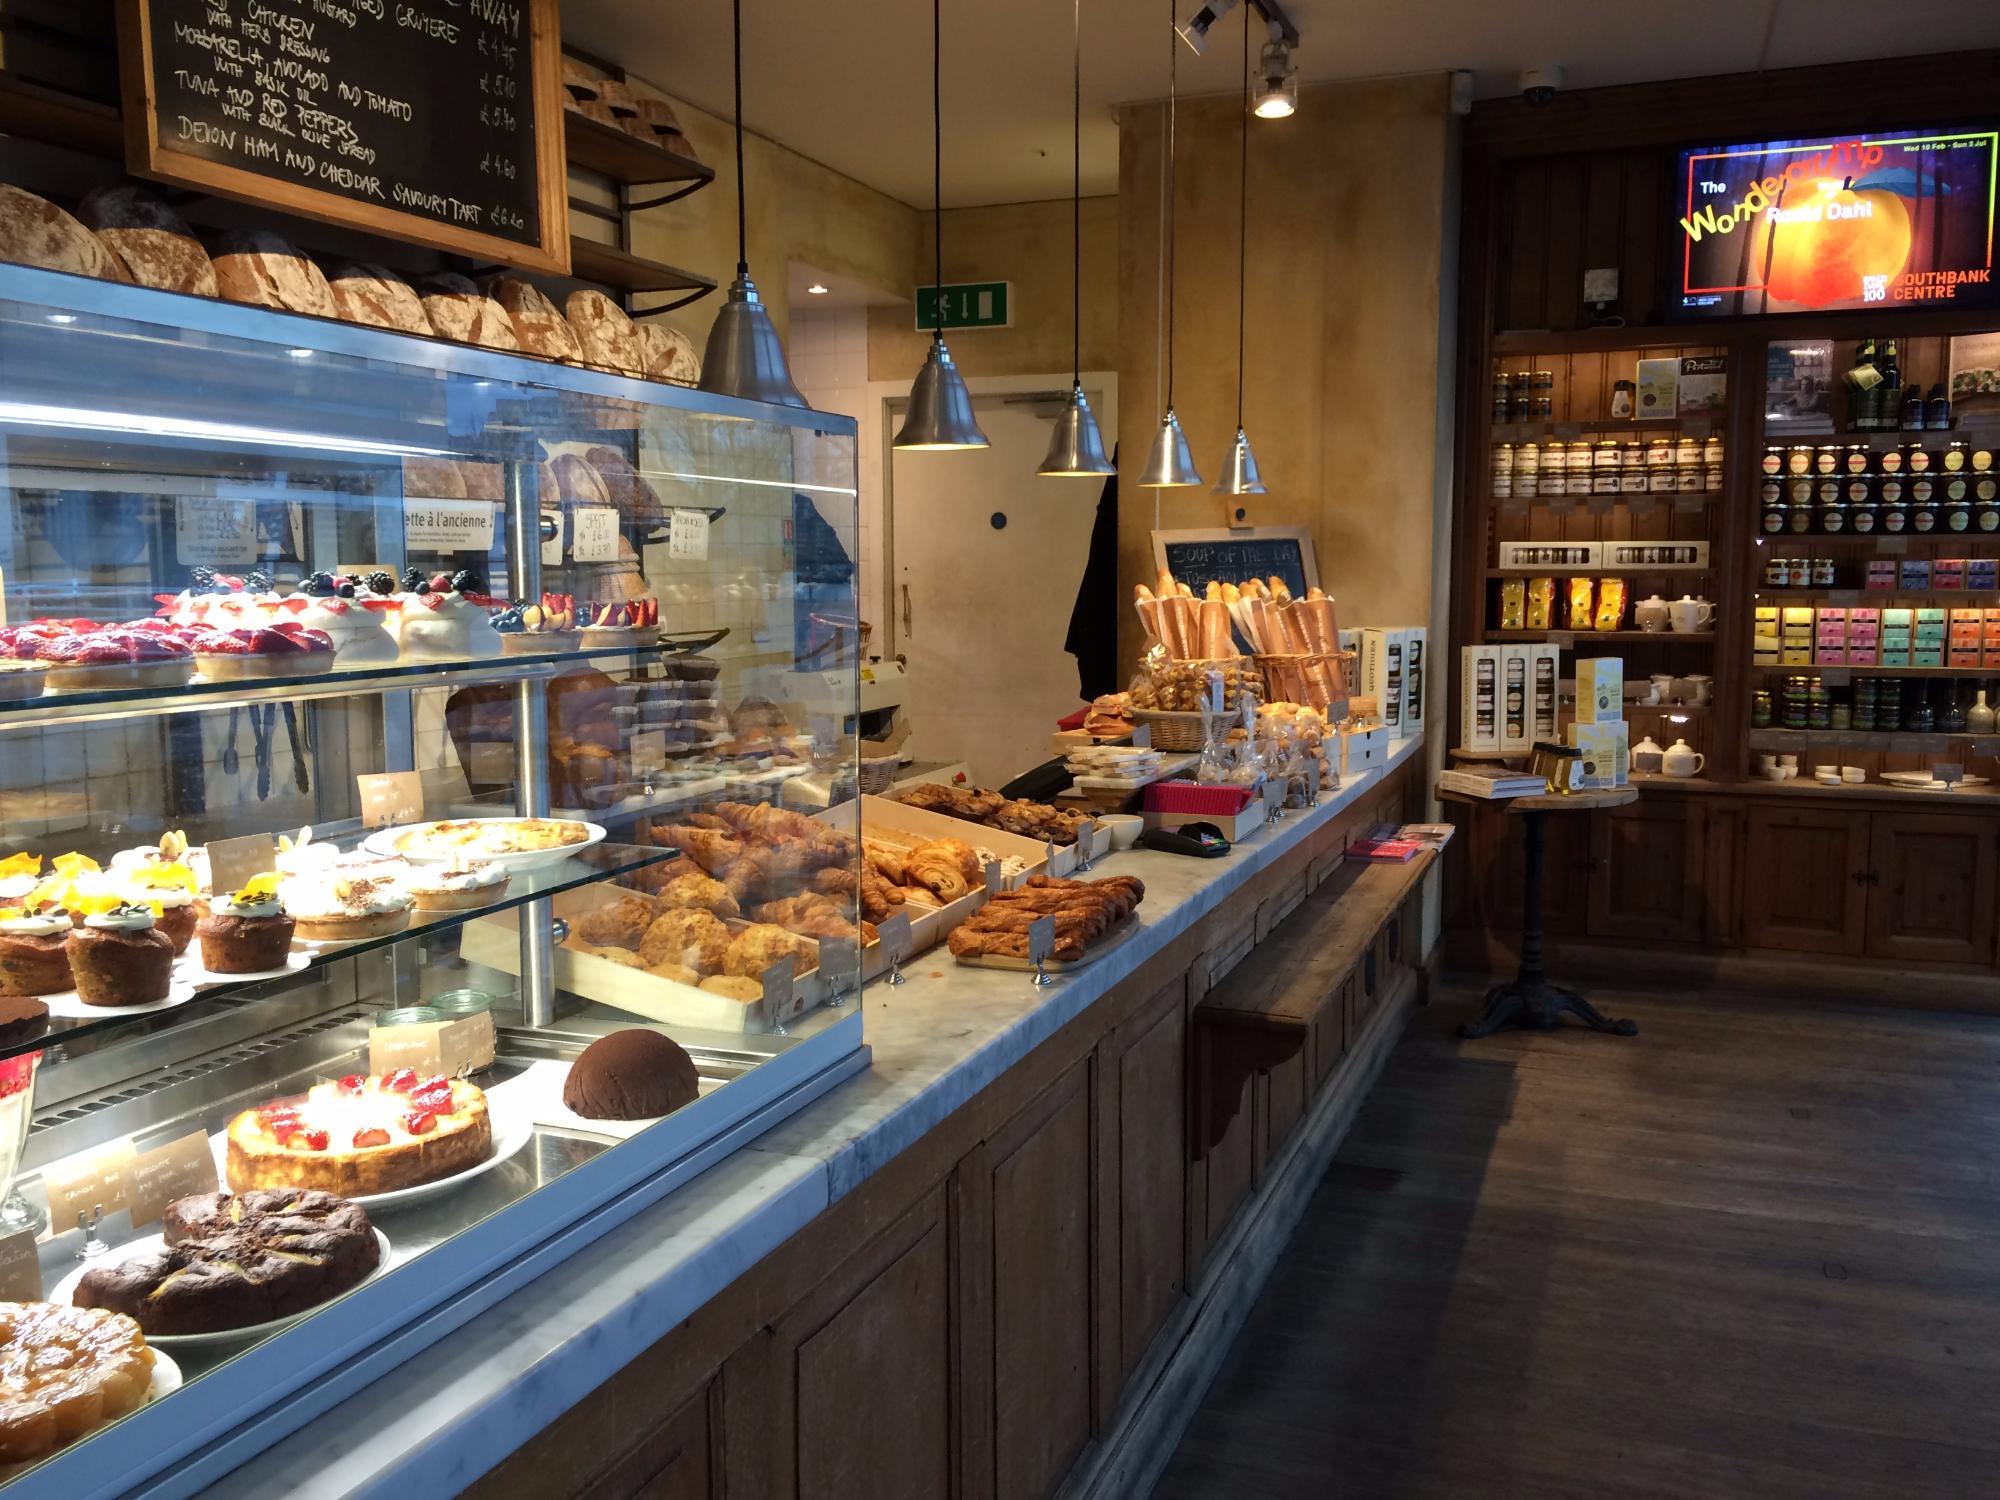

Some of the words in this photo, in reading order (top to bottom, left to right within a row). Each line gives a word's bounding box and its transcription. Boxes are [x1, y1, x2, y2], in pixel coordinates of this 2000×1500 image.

[247, 0, 315, 41] CHICKEN
[313, 0, 356, 28] MUSTARD
[396, 4, 460, 44] GRUYERE
[470, 0, 519, 39] AWAY
[206, 8, 232, 29] WITH
[241, 17, 271, 45] HERB
[279, 34, 331, 63] DRESSING
[213, 55, 243, 78] WITH
[255, 70, 290, 98] BASIL
[296, 87, 318, 106] OIL
[272, 57, 329, 92] AVOCADO
[338, 80, 361, 107] AND
[174, 69, 220, 98] TUNA
[226, 85, 254, 107] AND
[262, 92, 287, 119] RED
[293, 103, 360, 145] PEPPERS
[221, 102, 252, 122] WITH
[258, 113, 296, 138] BLACK
[301, 129, 332, 149] OLIVE
[337, 140, 376, 166] SPREAD
[1931, 142, 1946, 150] Feb
[1952, 141, 1968, 149] Sun
[1974, 139, 1987, 147] Jul
[177, 115, 237, 151] DEVON
[244, 135, 280, 162] HAM
[285, 148, 316, 176] AND
[319, 161, 386, 200] CHEDDAR
[392, 182, 448, 216] SAVOURY
[448, 197, 483, 225] TART
[1700, 181, 1727, 195] The
[1826, 201, 1873, 220] Dahl
[1893, 284, 1957, 300] CENTRE
[427, 511, 434, 526] à
[436, 511, 486, 528] l'ancienne
[1173, 545, 1215, 563] SOUP
[1216, 545, 1237, 564] OF
[1240, 545, 1267, 563] THE
[1272, 543, 1299, 562] DAY
